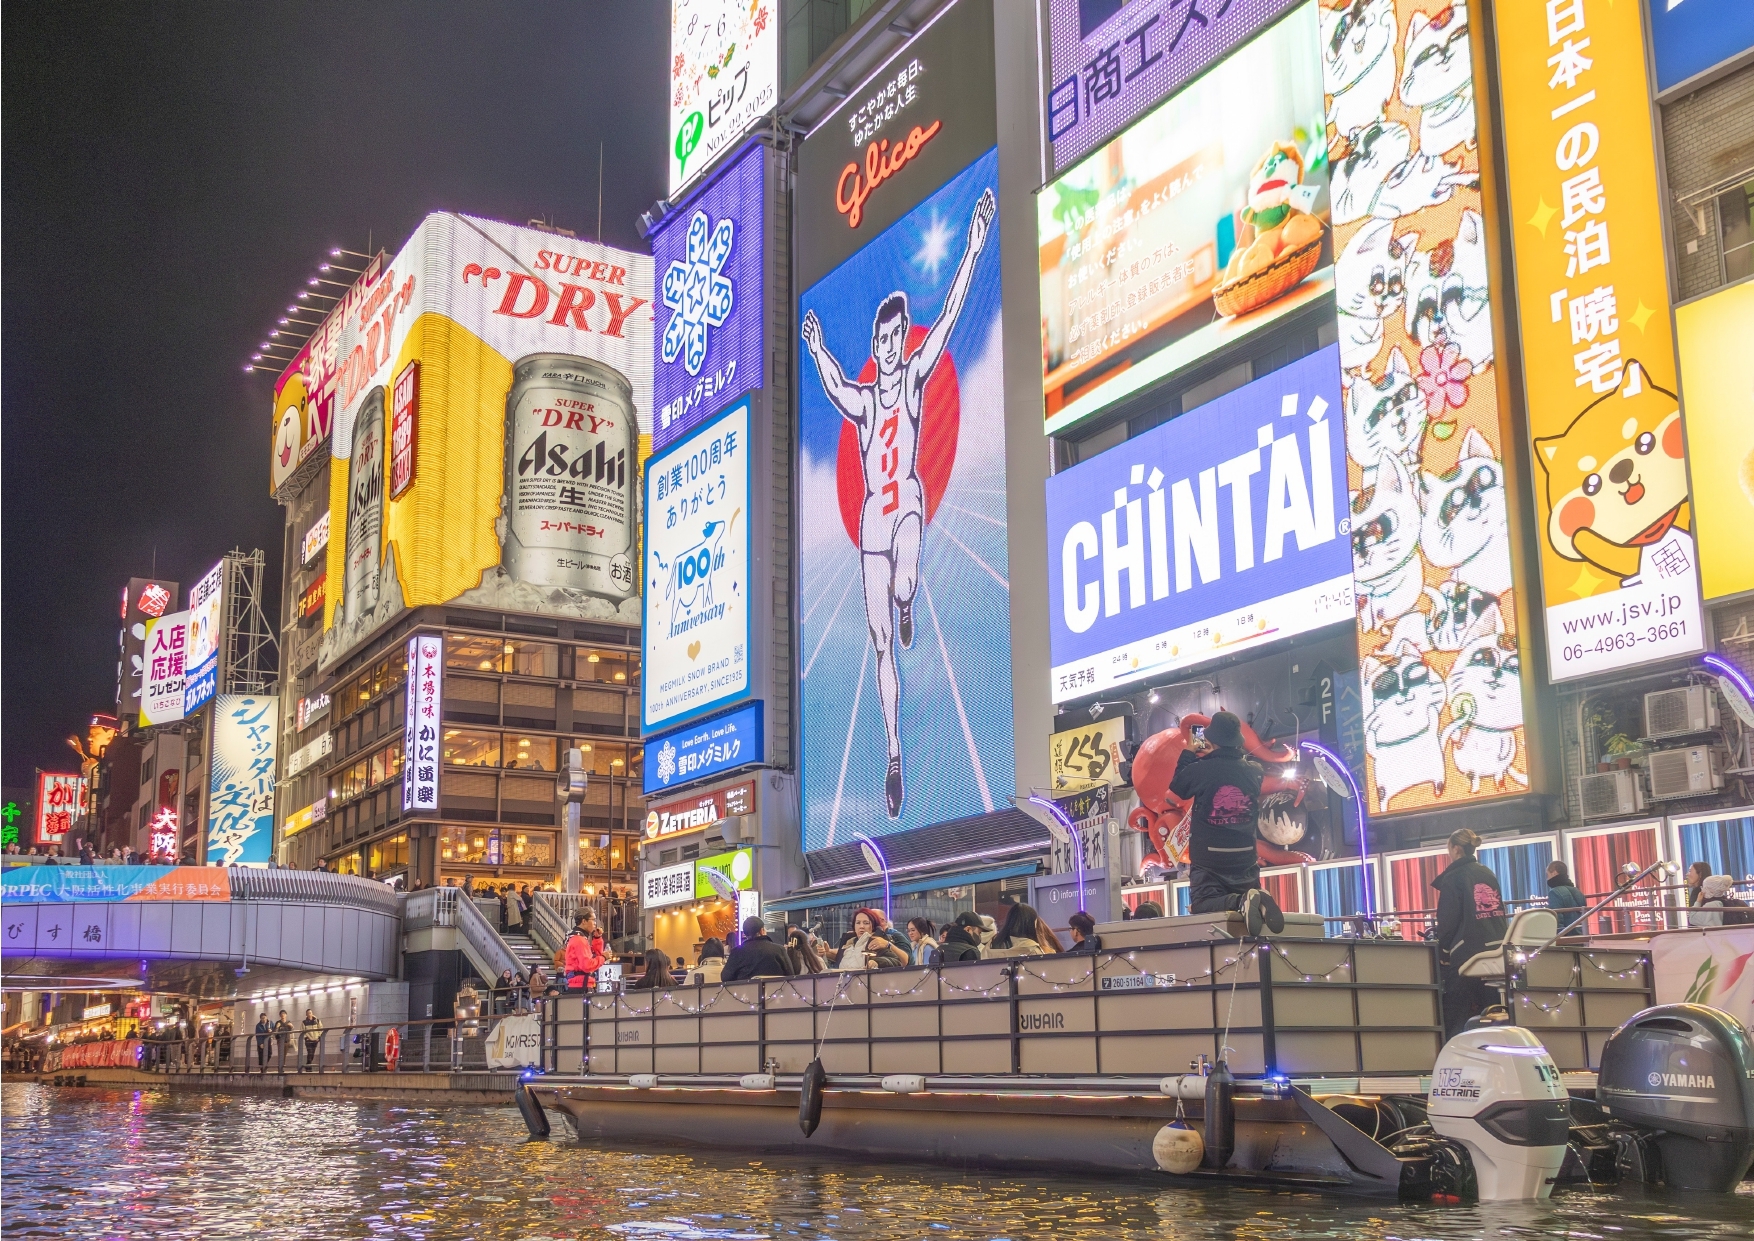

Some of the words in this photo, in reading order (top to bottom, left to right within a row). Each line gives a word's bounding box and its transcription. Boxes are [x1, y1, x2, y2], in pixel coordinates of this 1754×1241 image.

[687, 13, 699, 36] 8
[717, 13, 726, 37] 6
[1048, 0, 1231, 143] 日商エス
[708, 60, 751, 129] ピップ
[745, 83, 773, 116] 2025
[849, 59, 925, 132] すこやかな毎日、
[854, 84, 917, 146] ゆたかな人生
[836, 119, 943, 228] Glico
[534, 249, 627, 286] SUPER
[1068, 237, 1143, 289] お使いください。
[1069, 242, 1181, 316] アレルギー体質の方は、
[359, 269, 395, 332] SUPER
[1069, 259, 1195, 343] 必ず薬剤師、登録販売者に
[1070, 321, 1149, 368] ご相談ください。
[394, 371, 413, 418] ASAHI
[555, 398, 595, 412] SUPER
[661, 360, 737, 430] 雪印メグミルク
[393, 415, 412, 459] 1889
[392, 450, 410, 493] OSAKA
[518, 430, 625, 489] Asahi
[657, 430, 738, 501] 創業100周年
[879, 406, 899, 517] グリコ
[350, 459, 381, 529] Asahi
[559, 486, 586, 507] 生
[666, 474, 726, 529] ありがとう
[540, 520, 604, 538] スーパードライ
[557, 558, 586, 570] 生ビール
[611, 562, 632, 583] お酒
[677, 546, 726, 590] 100th
[666, 601, 726, 640] Anniversary
[1563, 593, 1682, 635] www.jsv.jp
[152, 624, 186, 654] 入店
[1563, 620, 1687, 661] 06-4963-3661
[422, 663, 436, 719] 本場の味
[660, 676, 685, 693] MEGMILK
[687, 667, 705, 682] SNOW
[708, 657, 730, 674] BRAND
[1060, 667, 1095, 692] 天気予報
[1320, 677, 1332, 724] 2F
[678, 739, 740, 775] 雪印メグミルク
[682, 739, 693, 749] Love
[712, 727, 725, 739] Love
[1064, 731, 1110, 781] くくる
[418, 725, 436, 803] かに道楽
[660, 804, 718, 835] ZETTERIA
[57, 882, 222, 897] 大阪活性化事業実行委員会
[1061, 888, 1097, 899] informtion
[1113, 976, 1144, 988] 260-51164
[1433, 1088, 1481, 1098] ELECTRINE
[1439, 1068, 1462, 1087] 115
[1661, 1073, 1716, 1089] YAMAHA
